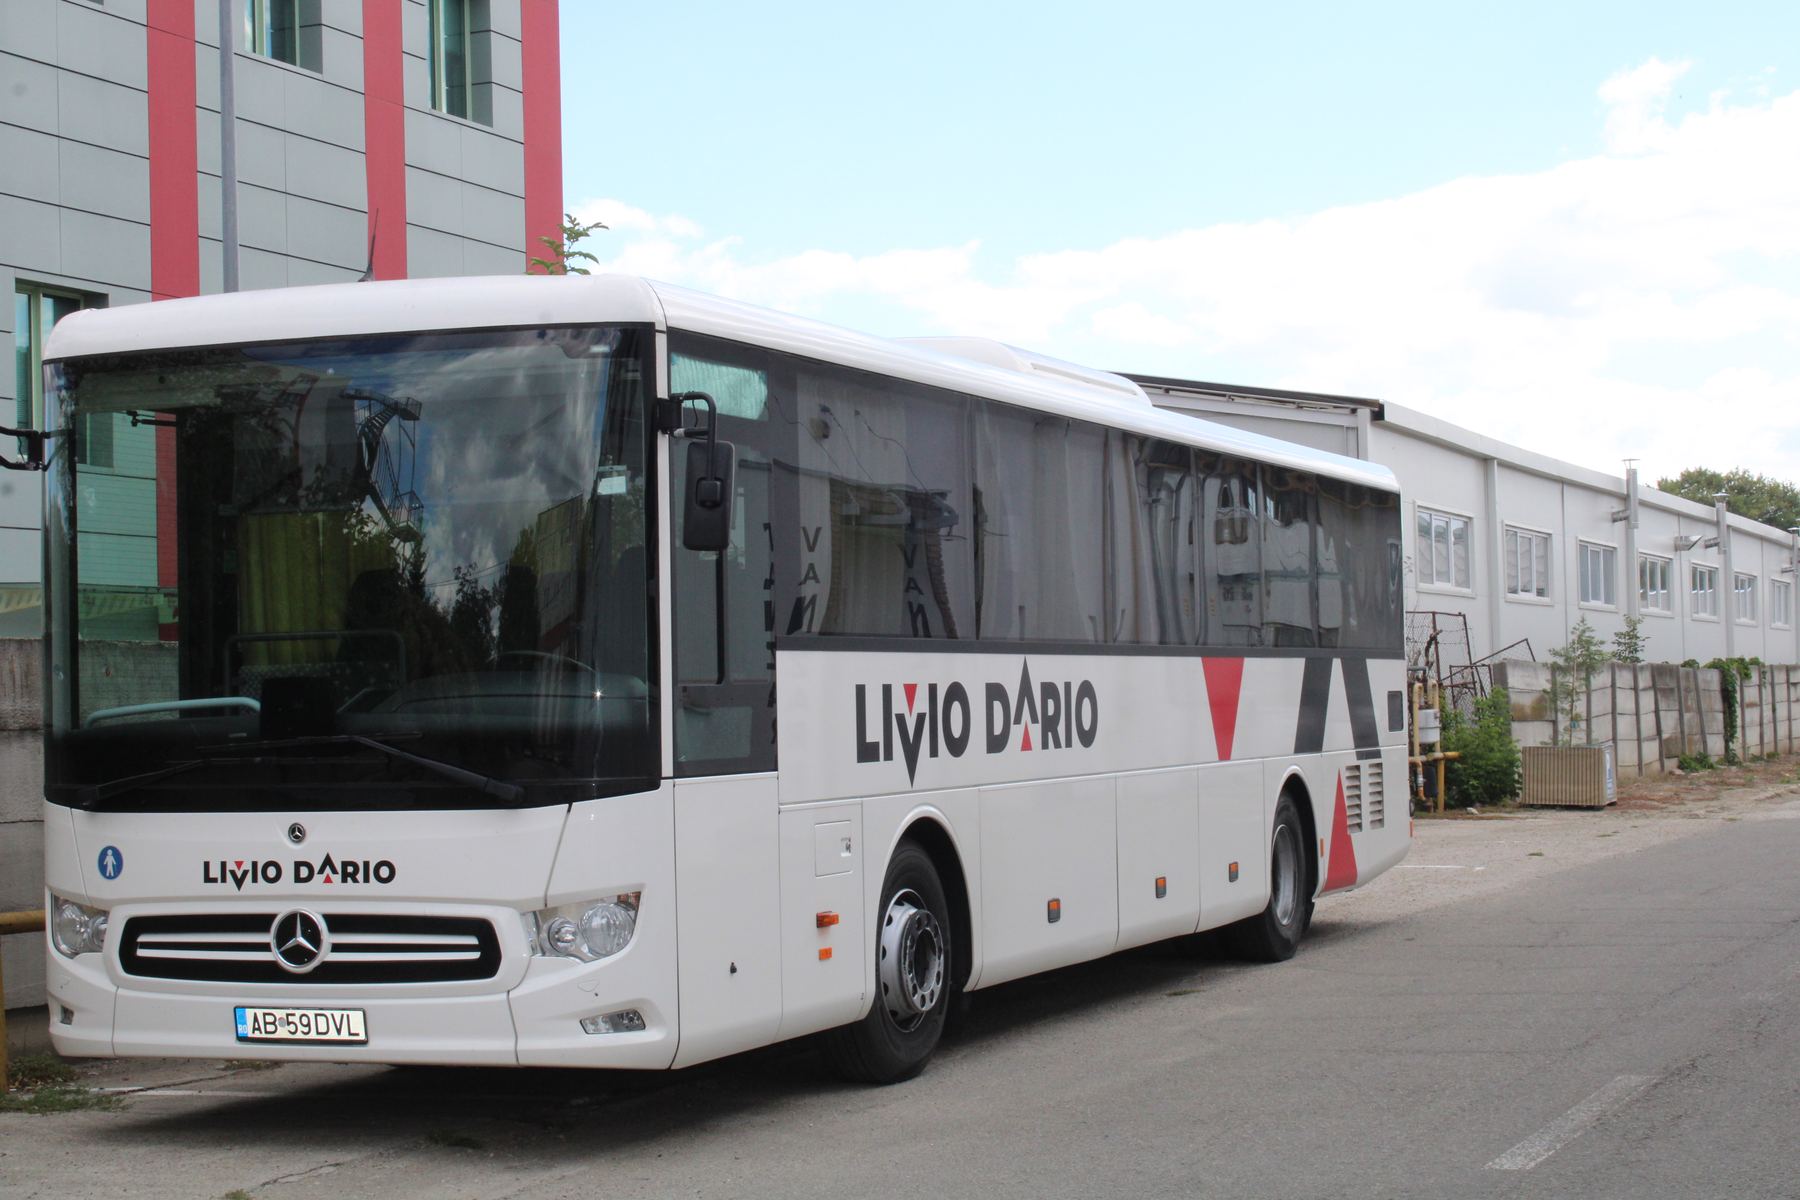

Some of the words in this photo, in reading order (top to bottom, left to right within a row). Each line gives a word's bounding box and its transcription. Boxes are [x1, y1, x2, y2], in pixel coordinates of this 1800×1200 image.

[855, 681, 971, 788] LIVIO
[985, 656, 1098, 754] DARIO
[203, 860, 282, 892] LIVIO
[293, 852, 396, 884] DARIO
